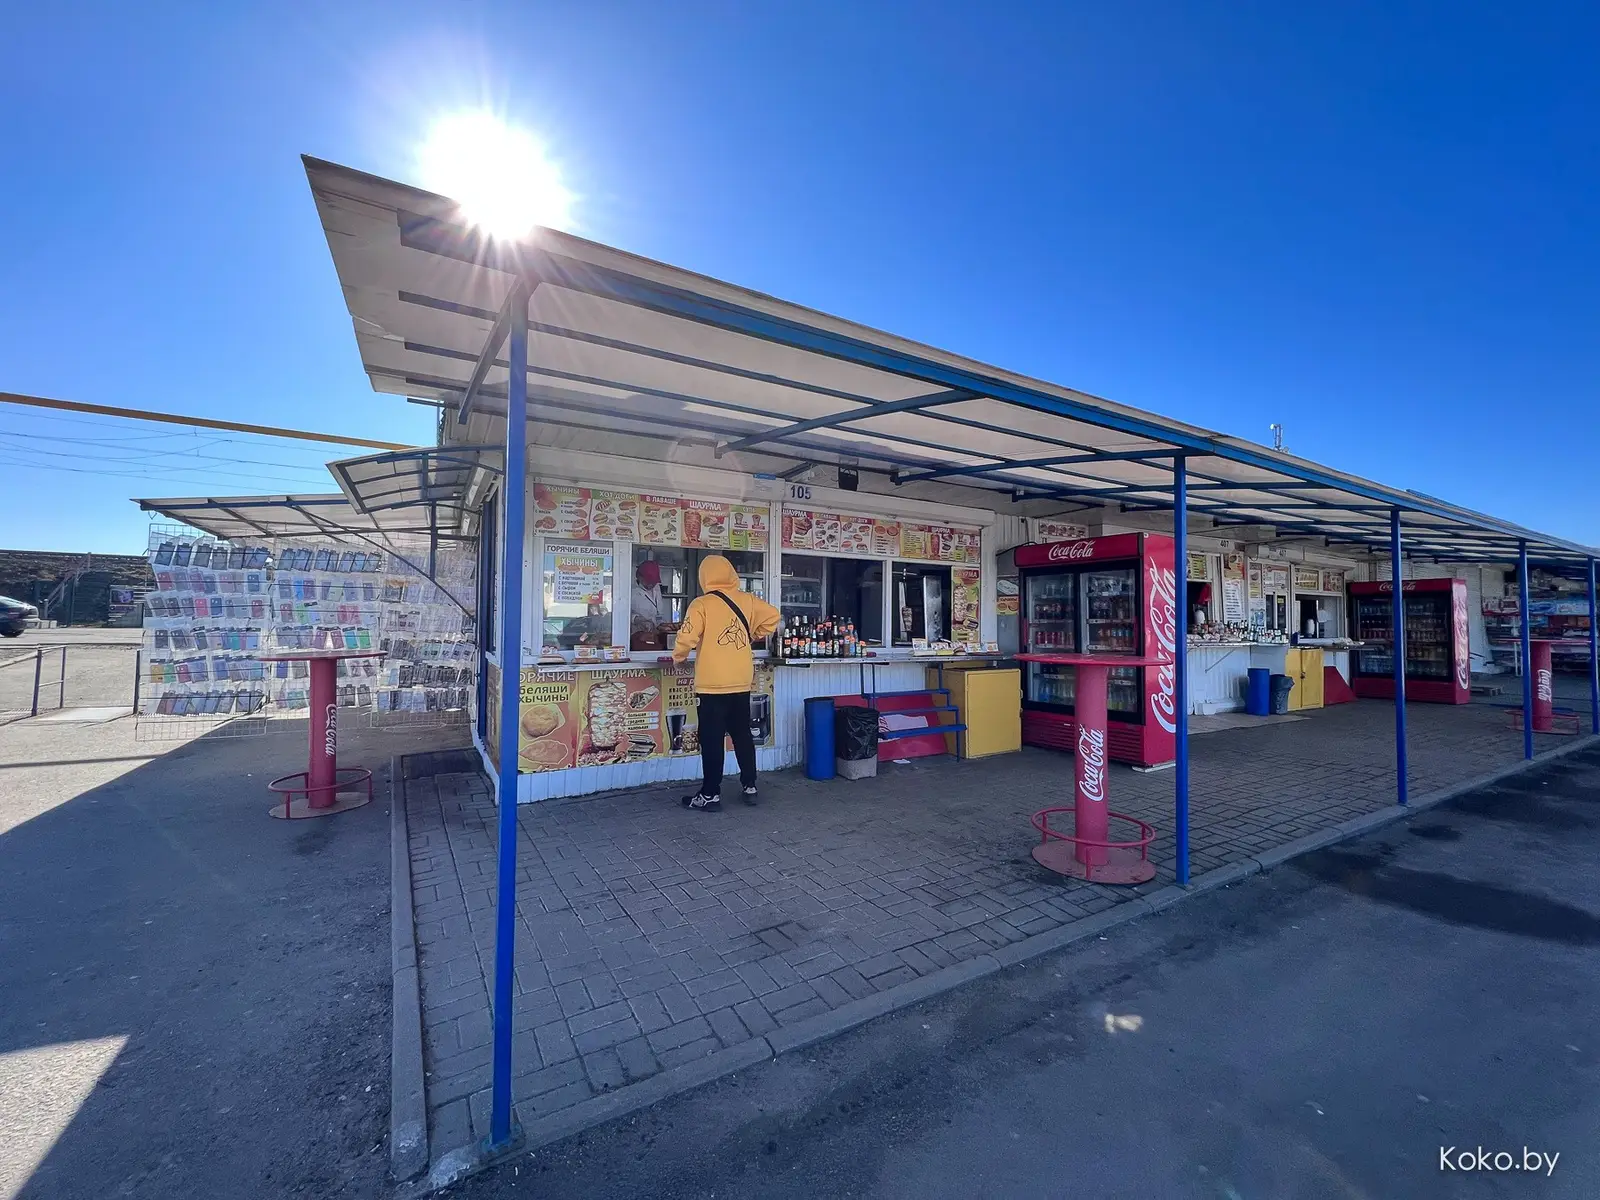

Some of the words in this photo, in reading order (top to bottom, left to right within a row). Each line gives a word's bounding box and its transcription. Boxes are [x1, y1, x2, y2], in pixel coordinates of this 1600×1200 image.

[790, 485, 811, 500] 105
[689, 500, 722, 511] ШАУРМА
[783, 508, 807, 518] ШАУРМА
[547, 545, 579, 554] ГОРЯЧИЕ
[580, 547, 610, 555] БЕЛЯШИ
[561, 557, 598, 567] ХЫЧИНЫ
[519, 671, 575, 683] ОРЯЧИЕ
[591, 669, 647, 680] ШАУРМА
[519, 685, 568, 695] беляши
[519, 694, 569, 703] хычины
[1078, 724, 1105, 802] Coca-Cola
